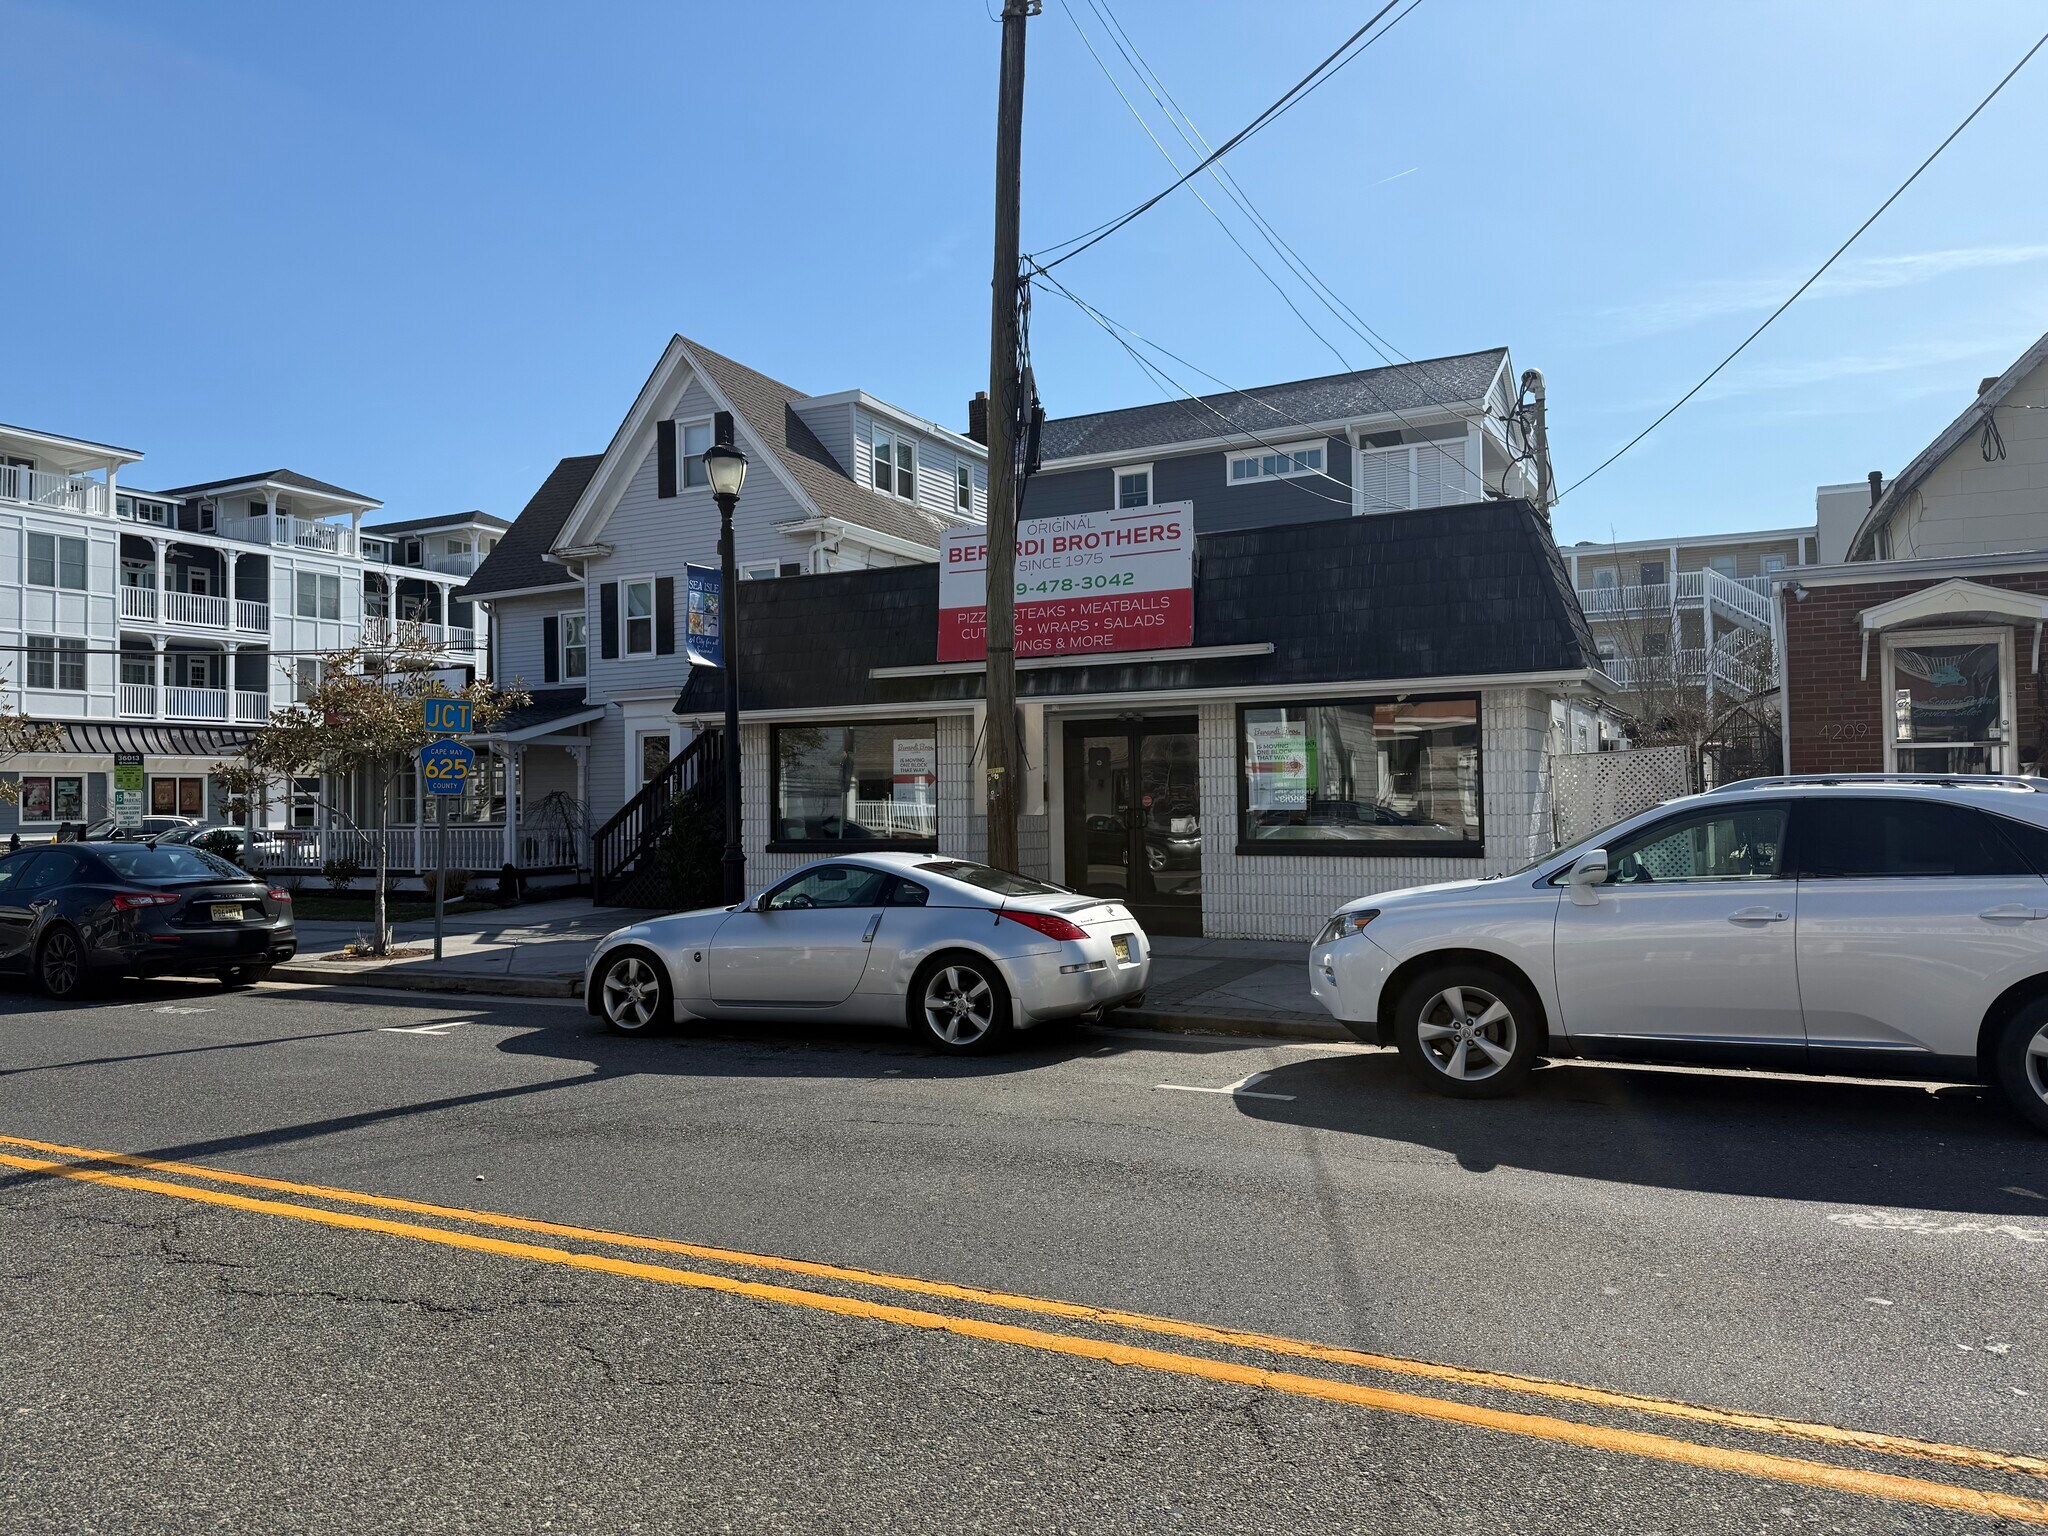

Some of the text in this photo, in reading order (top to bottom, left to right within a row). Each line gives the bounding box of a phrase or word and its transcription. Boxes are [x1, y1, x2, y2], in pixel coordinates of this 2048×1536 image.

[1026, 517, 1096, 536] ORIGINAL
[948, 522, 1182, 564] BERRDI BROTHERS
[1019, 552, 1104, 572] SINCE 1975
[688, 579, 719, 593] SEA ISLE
[957, 611, 987, 625] PIZZ
[1080, 596, 1170, 615] MEATBALLS
[1037, 619, 1089, 634] WRAPS
[1103, 613, 1165, 628] SALADS
[1056, 635, 1066, 649] &
[1069, 634, 1114, 648] MORE
[427, 704, 470, 728] JCT
[1818, 722, 1868, 740] 4209
[425, 758, 468, 779] 625
[116, 794, 123, 802] 15
